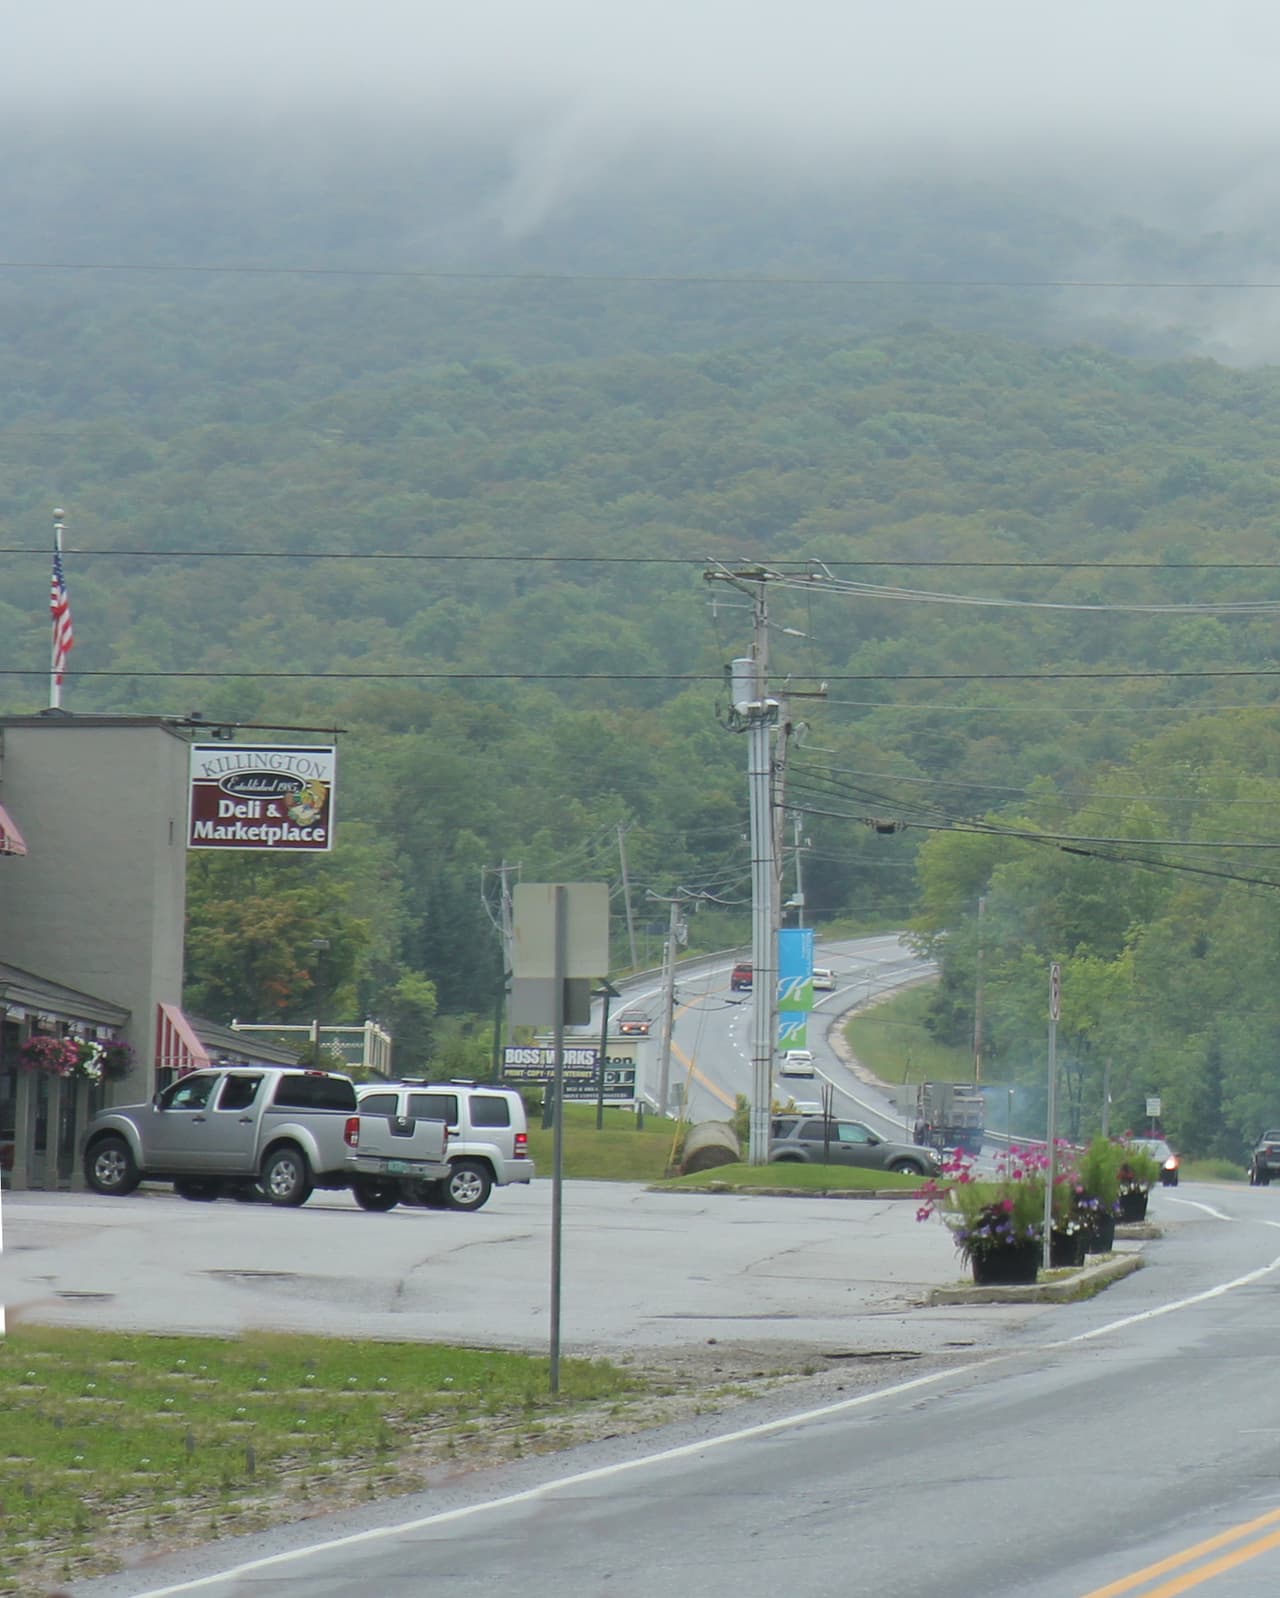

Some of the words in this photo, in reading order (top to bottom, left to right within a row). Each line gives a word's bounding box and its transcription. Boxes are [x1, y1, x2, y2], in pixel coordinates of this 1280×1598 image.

[201, 753, 327, 778] KILLINGTON
[218, 800, 260, 818] Deli
[266, 804, 283, 818] &
[193, 821, 326, 846] Marketplace
[505, 1049, 540, 1064] BOSS
